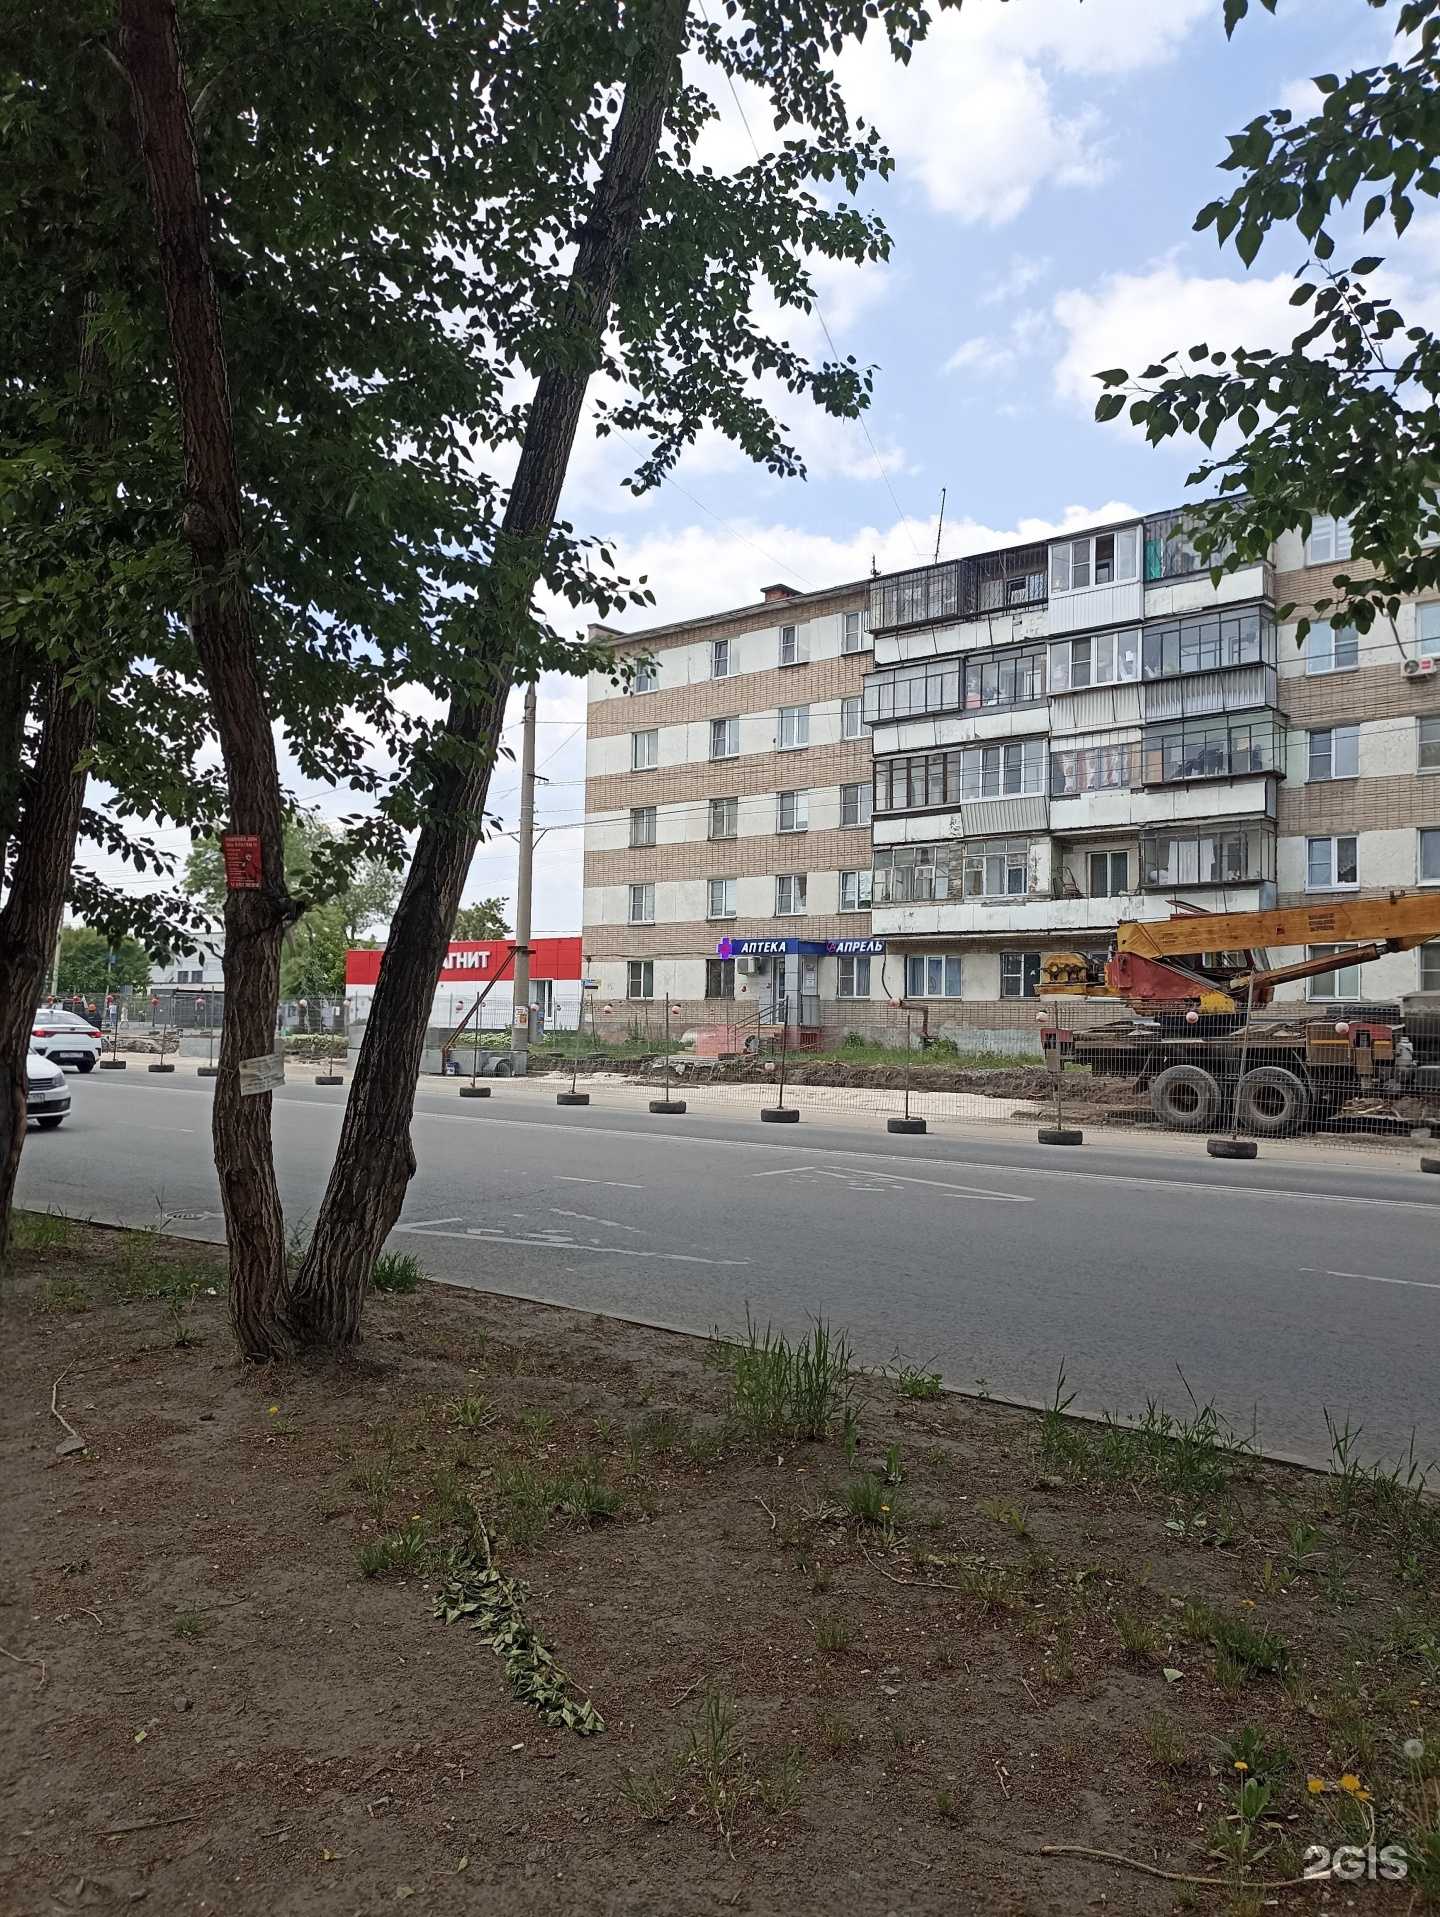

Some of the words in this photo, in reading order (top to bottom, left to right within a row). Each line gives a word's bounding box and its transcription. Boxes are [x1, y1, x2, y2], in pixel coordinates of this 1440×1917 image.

[741, 941, 786, 954] АПТЕКА
[835, 941, 883, 954] АПРЕЛЬ
[442, 951, 491, 969] АГНИТ
